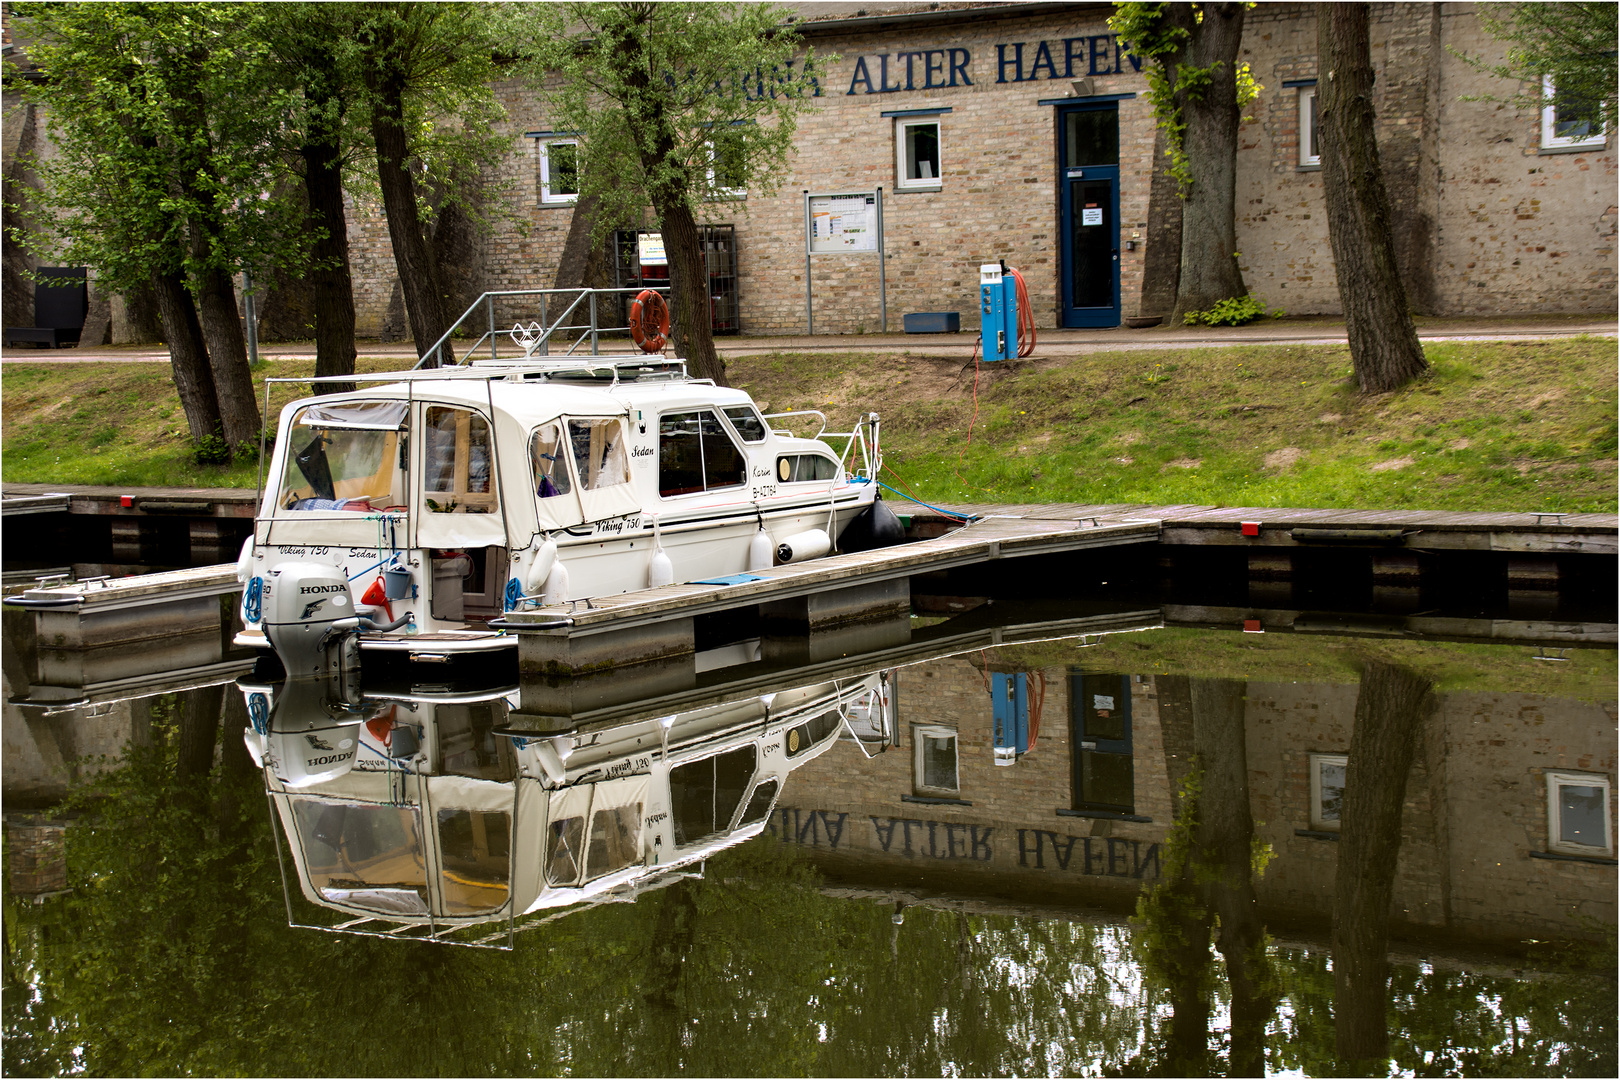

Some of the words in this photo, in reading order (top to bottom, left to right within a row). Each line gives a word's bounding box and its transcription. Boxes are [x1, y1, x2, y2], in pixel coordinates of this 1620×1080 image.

[846, 47, 974, 96] ALTER
[994, 33, 1143, 84] HAFEN
[631, 445, 654, 457] Sedan
[595, 520, 623, 534] Viking
[626, 517, 640, 529] 750
[277, 546, 306, 557] Viking
[310, 546, 329, 556] 750
[348, 547, 377, 559] Sedan
[300, 584, 347, 595] HONDA
